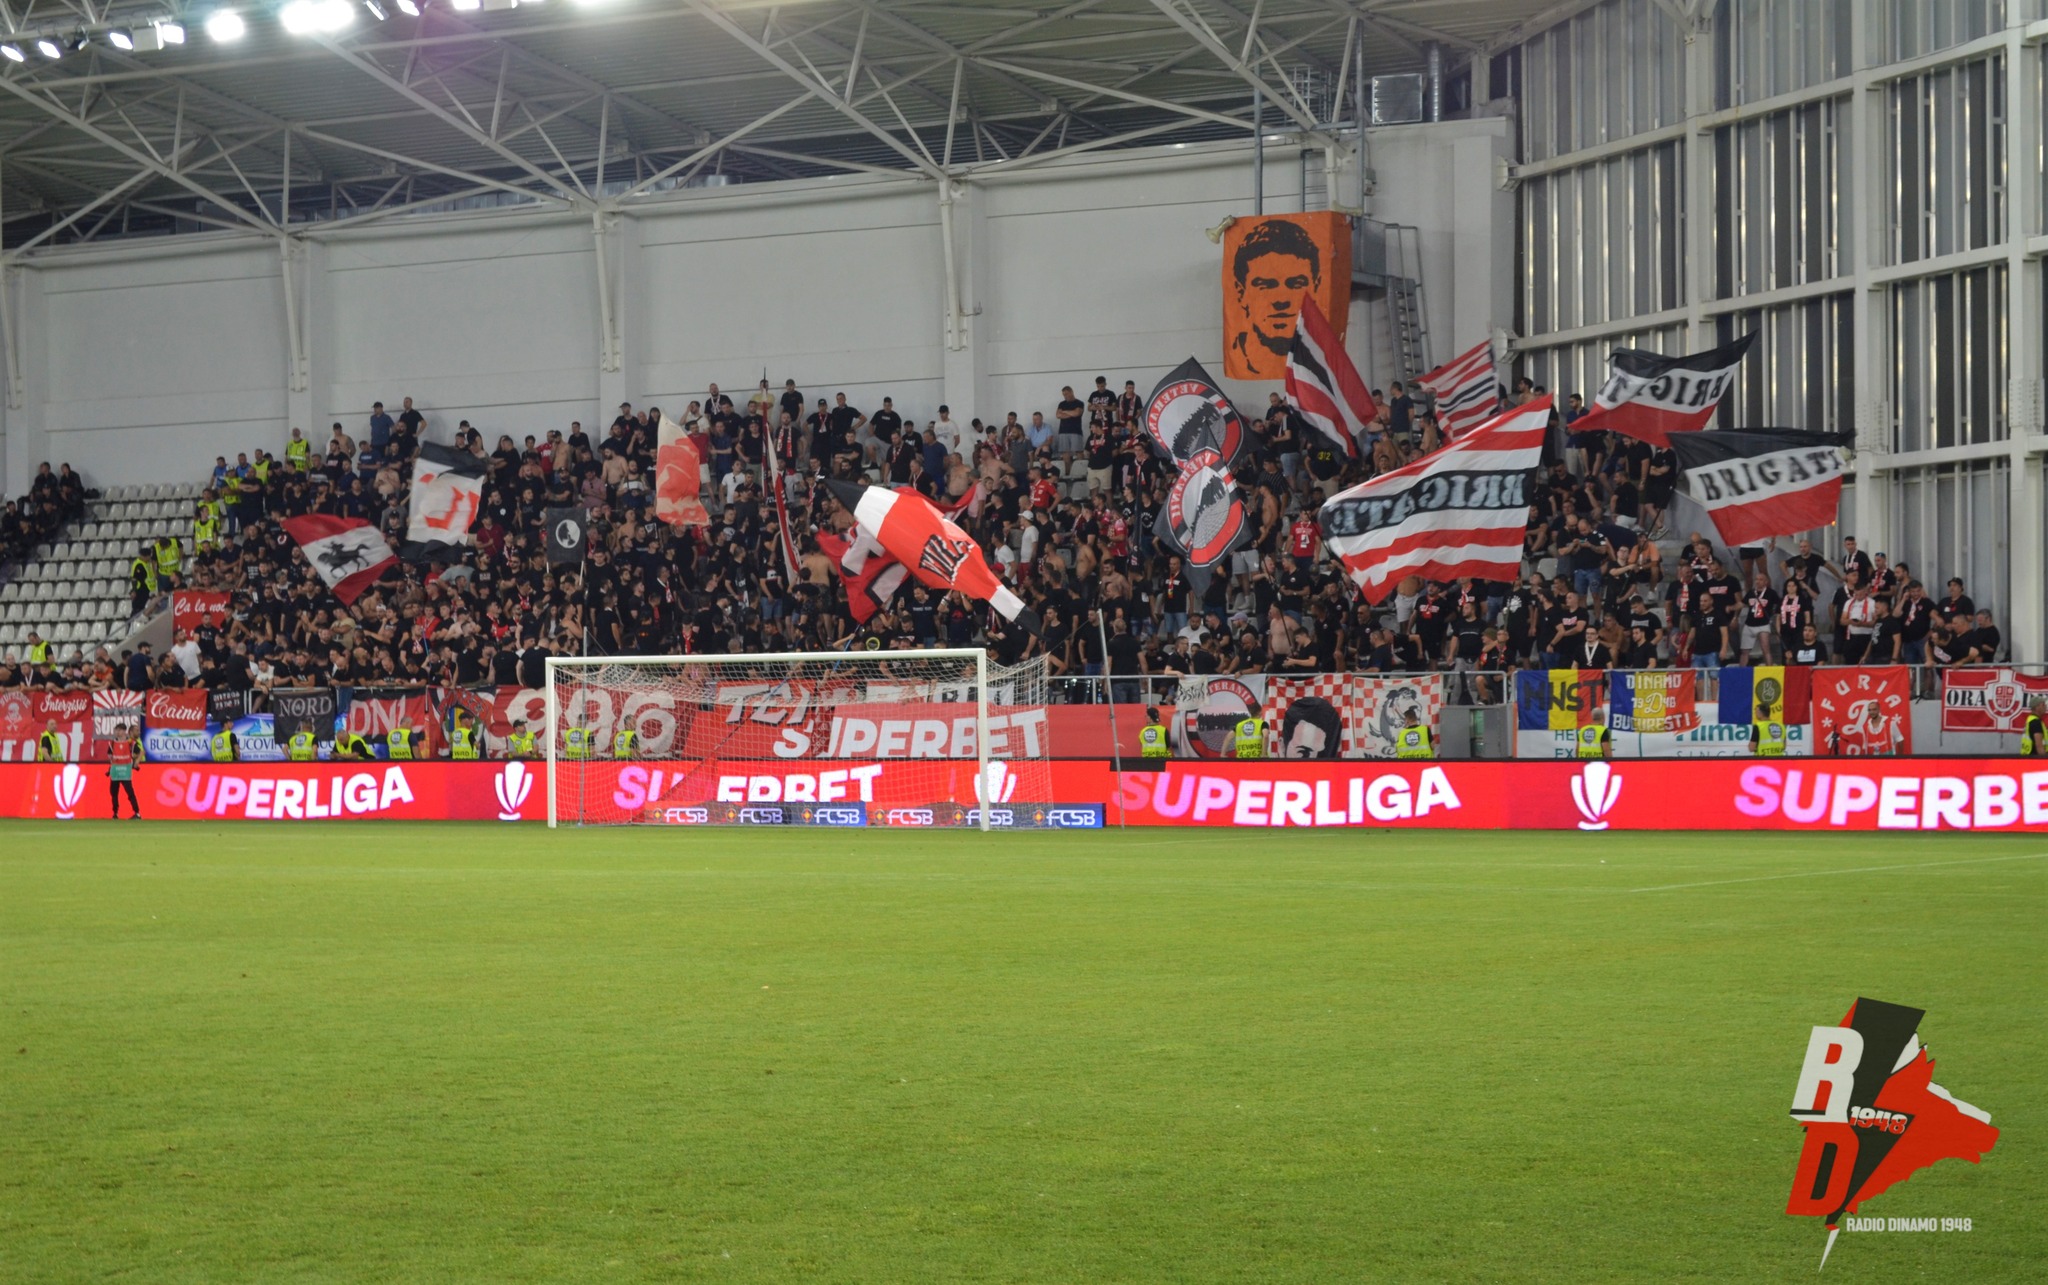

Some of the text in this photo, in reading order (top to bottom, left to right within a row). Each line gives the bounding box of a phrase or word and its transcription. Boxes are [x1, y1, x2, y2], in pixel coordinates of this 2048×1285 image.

[1625, 674, 1682, 690] DINAMO
[1208, 681, 1252, 702] TERANII
[1820, 674, 1902, 712] FURIA
[279, 696, 333, 717] NORD
[149, 738, 209, 752] BUCOVINA
[155, 766, 413, 820] SUPERLIGA
[1111, 766, 1462, 827] SUPERLIGA
[664, 807, 708, 823] FCSB
[738, 808, 783, 824] FCSB
[814, 808, 860, 824] FCSB
[887, 809, 934, 825] FCSB
[965, 809, 1014, 825] FSB
[1046, 809, 1096, 826] FCSB
